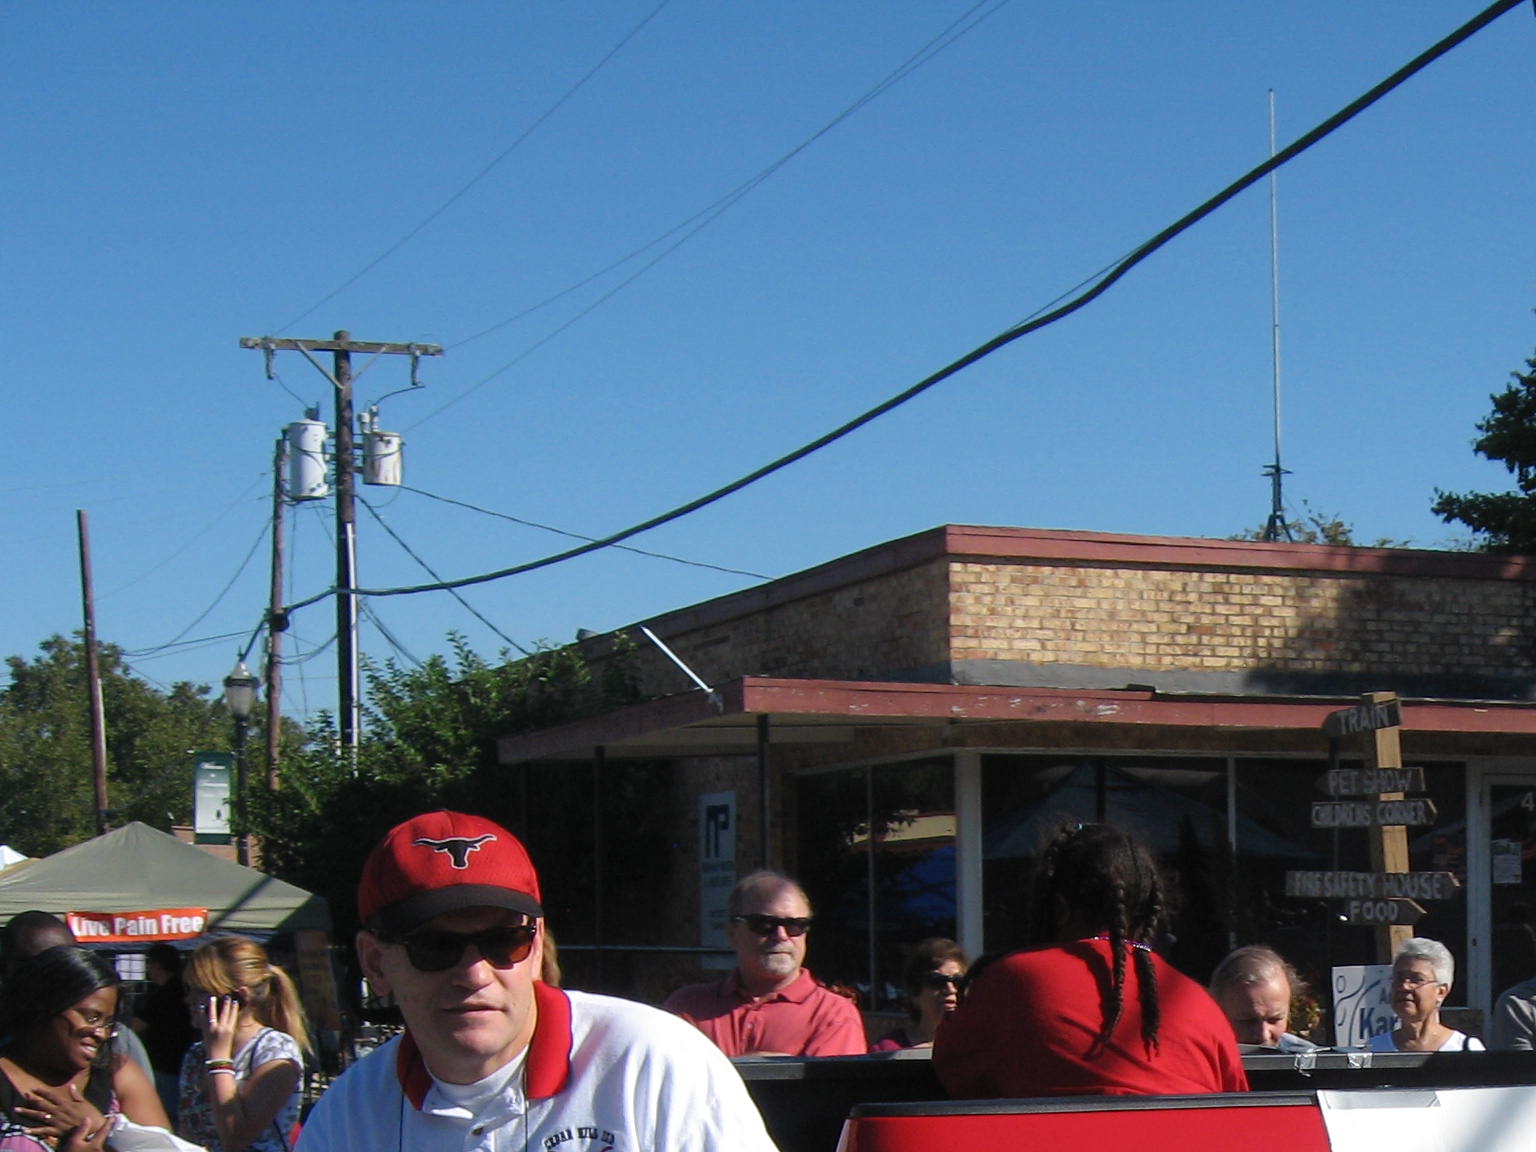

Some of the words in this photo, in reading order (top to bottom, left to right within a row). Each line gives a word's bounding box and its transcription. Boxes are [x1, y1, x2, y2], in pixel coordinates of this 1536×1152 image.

[1339, 704, 1389, 735] TRAIN
[1328, 771, 1359, 796] PET
[1364, 769, 1412, 794] SHOW
[1376, 801, 1428, 825] CORNER
[1323, 872, 1376, 898] SAFETY
[1383, 873, 1443, 900] HOUSE
[1349, 902, 1399, 922] FOOD
[71, 916, 110, 937] Live
[114, 916, 158, 936] Pain
[160, 914, 204, 934] Free
